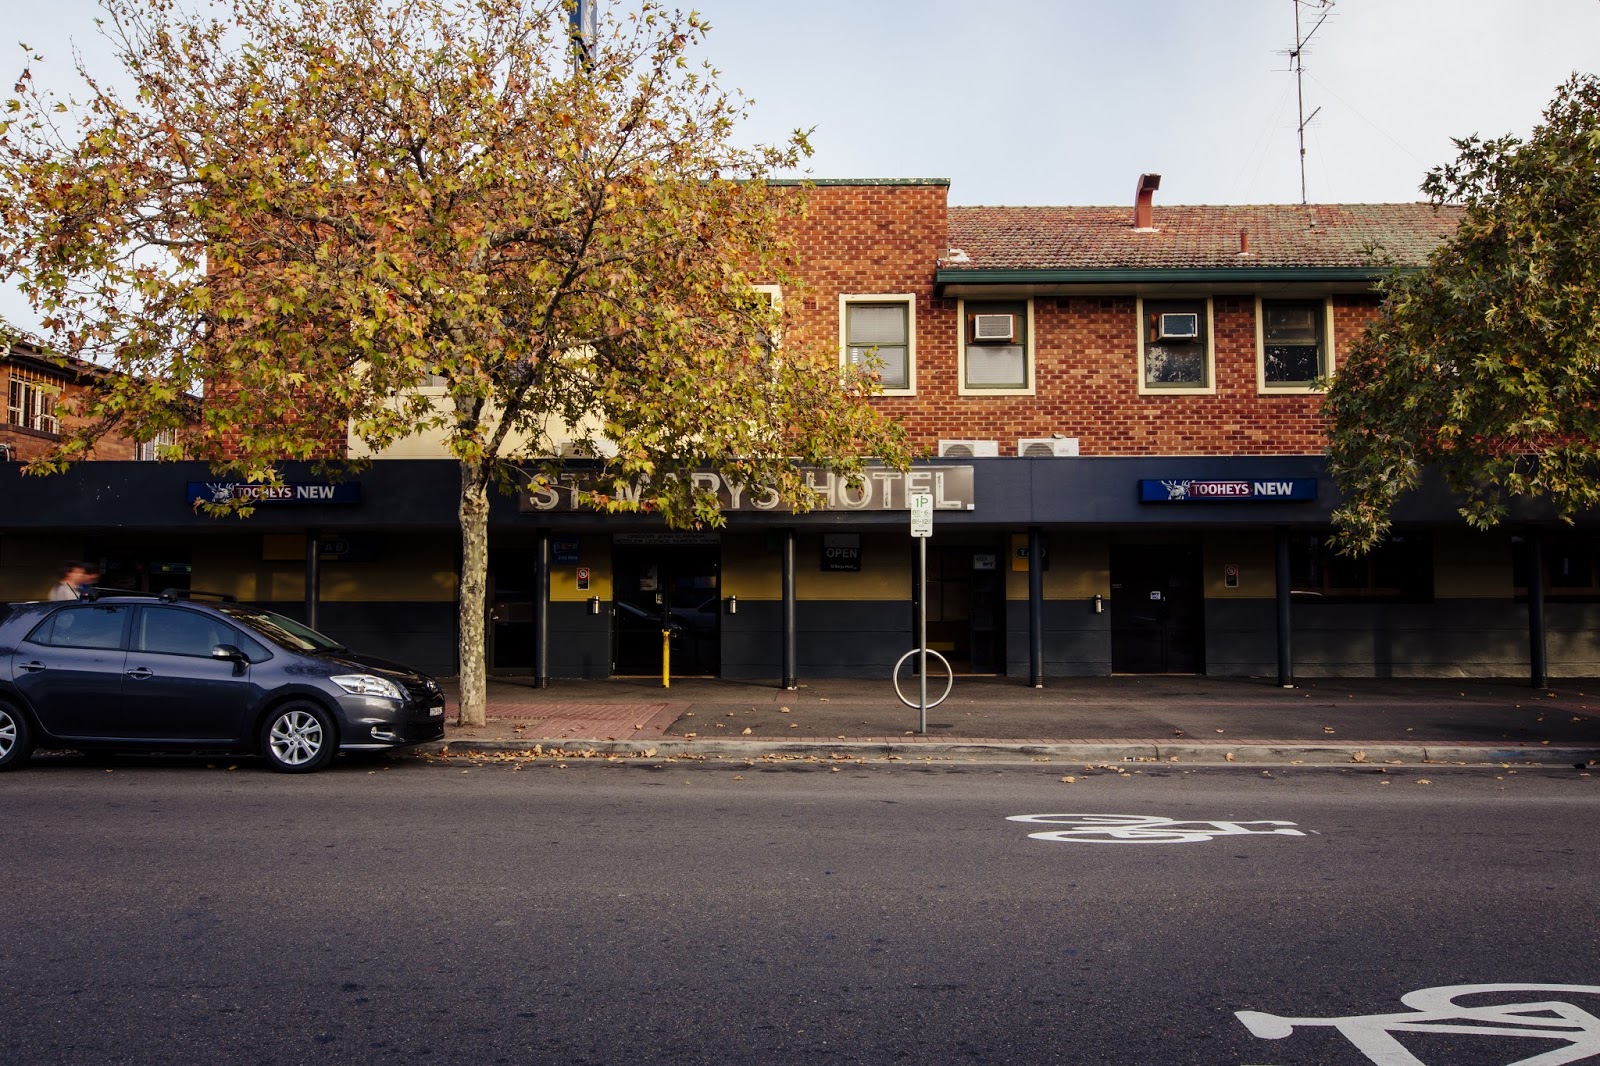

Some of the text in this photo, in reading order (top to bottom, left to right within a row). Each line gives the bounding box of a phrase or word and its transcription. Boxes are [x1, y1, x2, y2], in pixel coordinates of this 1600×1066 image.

[297, 485, 335, 499] NEW
[529, 472, 590, 510] ST
[806, 470, 961, 509] HOTEL
[1194, 482, 1293, 496] TOOHEYS NEW
[915, 497, 929, 508] 1P
[826, 548, 857, 558] OPEN
